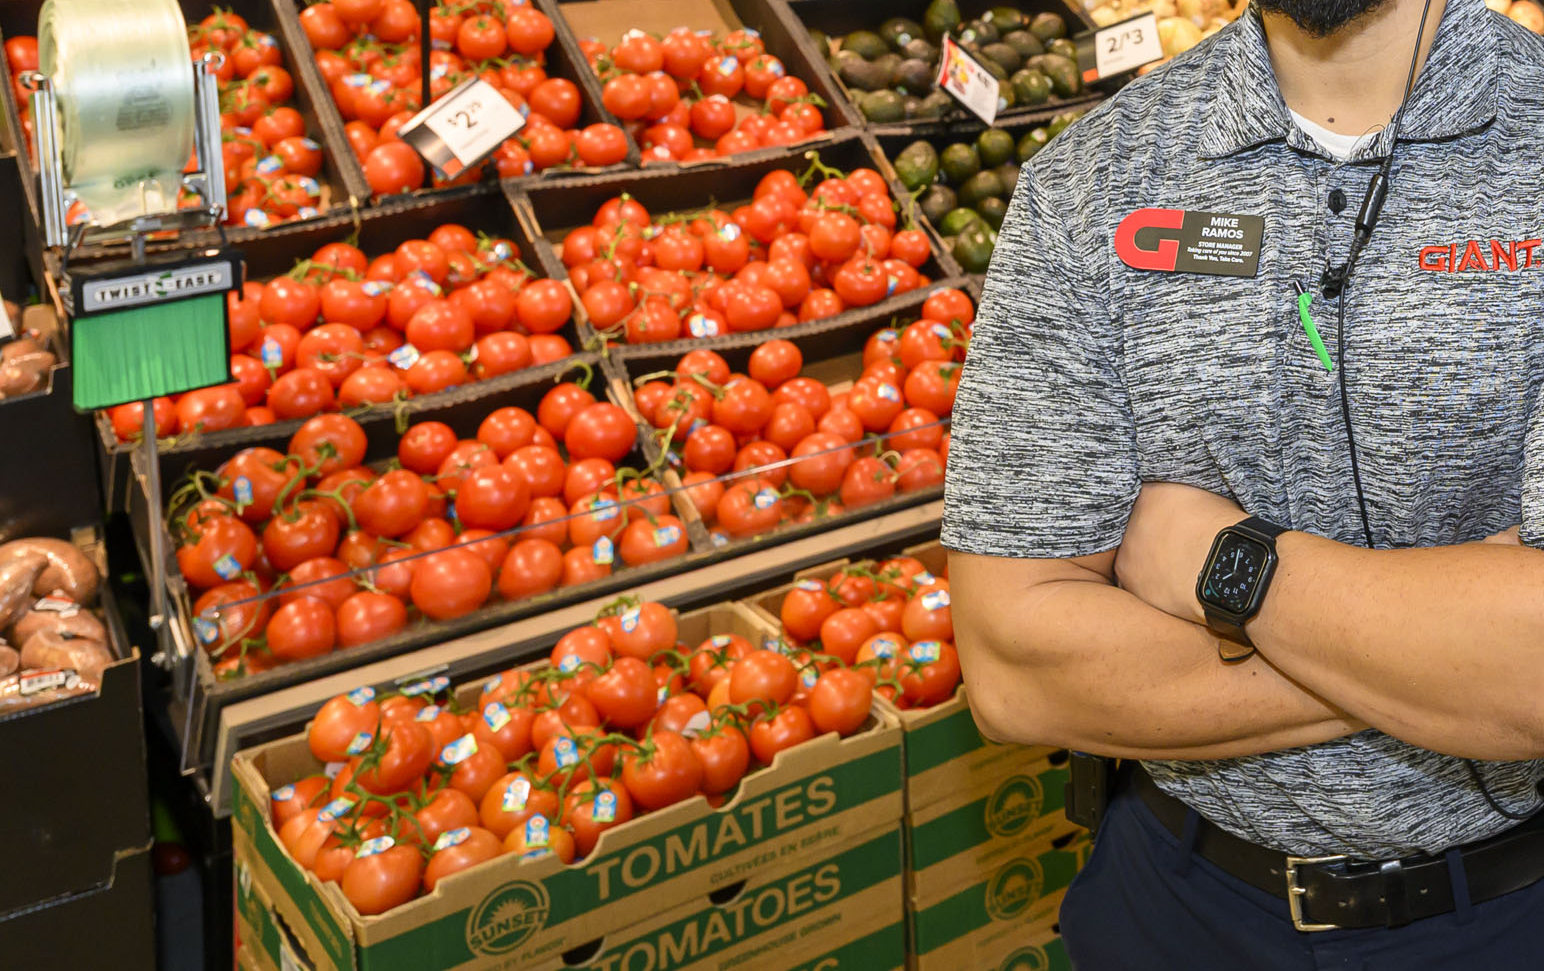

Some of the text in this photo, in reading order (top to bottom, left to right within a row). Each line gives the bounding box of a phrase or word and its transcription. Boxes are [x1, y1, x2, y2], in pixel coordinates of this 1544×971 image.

[1210, 216, 1239, 227] MIKE
[1201, 227, 1244, 239] RAMOS
[1216, 242, 1243, 250] MANAGER
[1418, 238, 1542, 273] GIANT
[99, 273, 217, 301] TWIST EASE
[587, 775, 837, 901] TOMATES
[780, 844, 797, 856] EN
[470, 910, 544, 949] SUNSET
